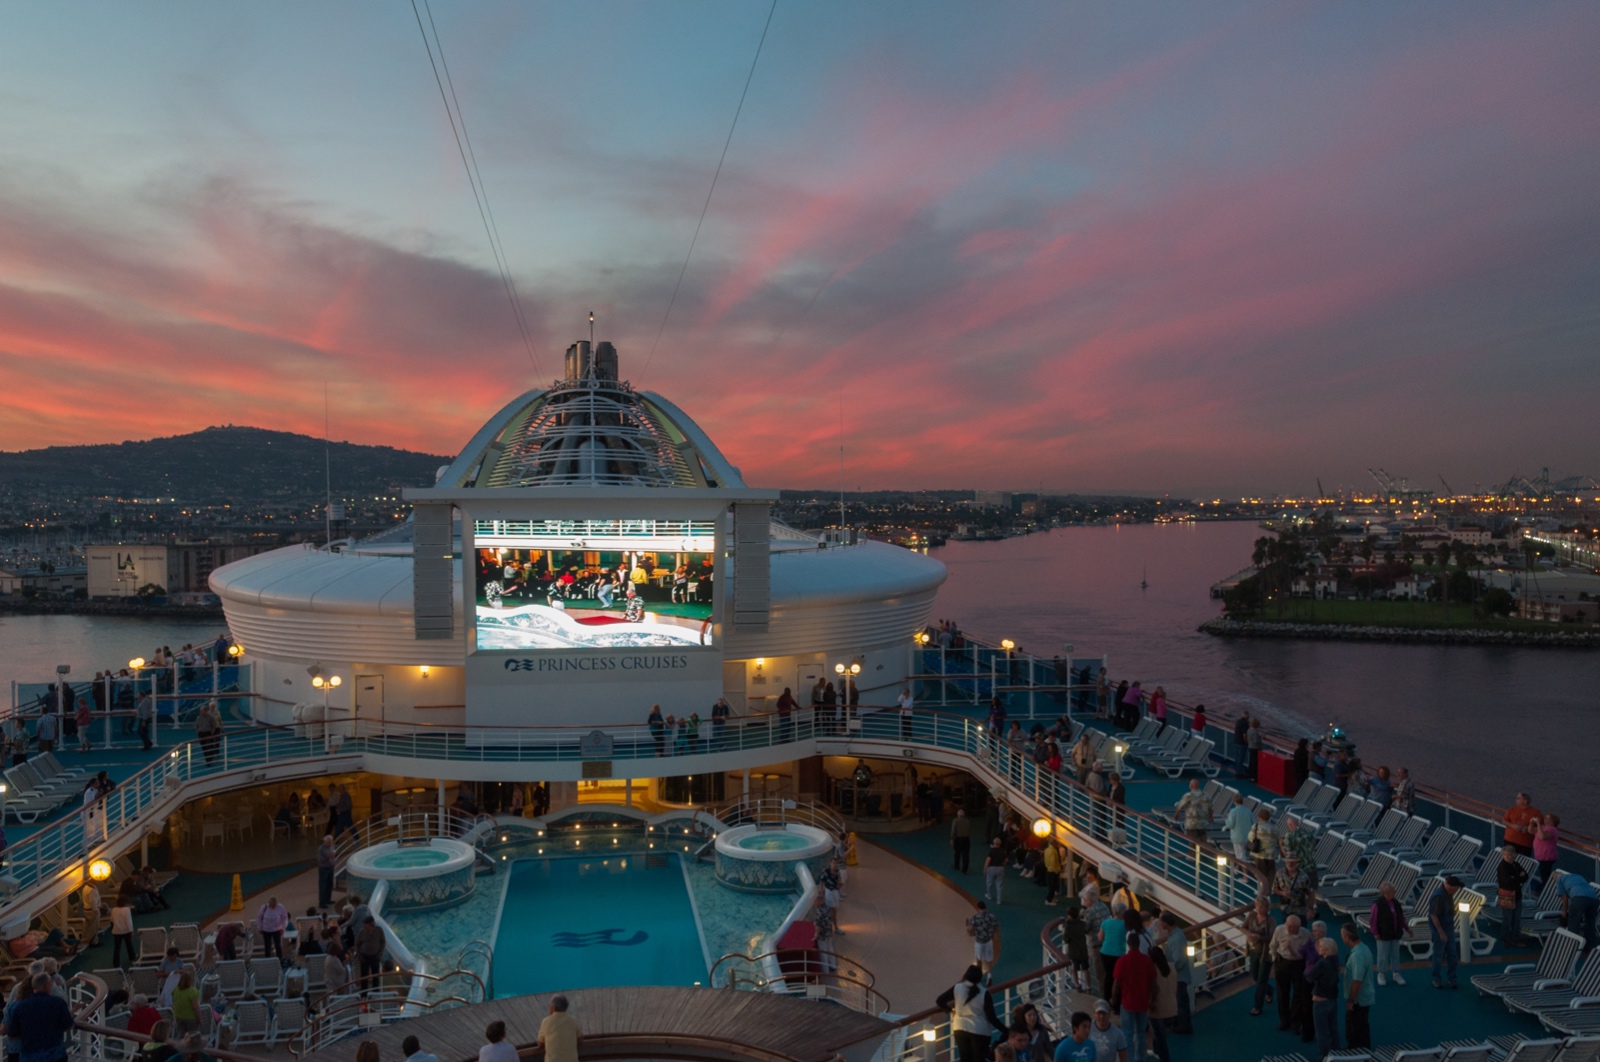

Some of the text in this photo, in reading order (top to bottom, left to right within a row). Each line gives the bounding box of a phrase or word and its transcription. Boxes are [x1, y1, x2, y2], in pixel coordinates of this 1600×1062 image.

[117, 552, 135, 571] LA
[538, 655, 688, 672] PRINCESS CRUISES
